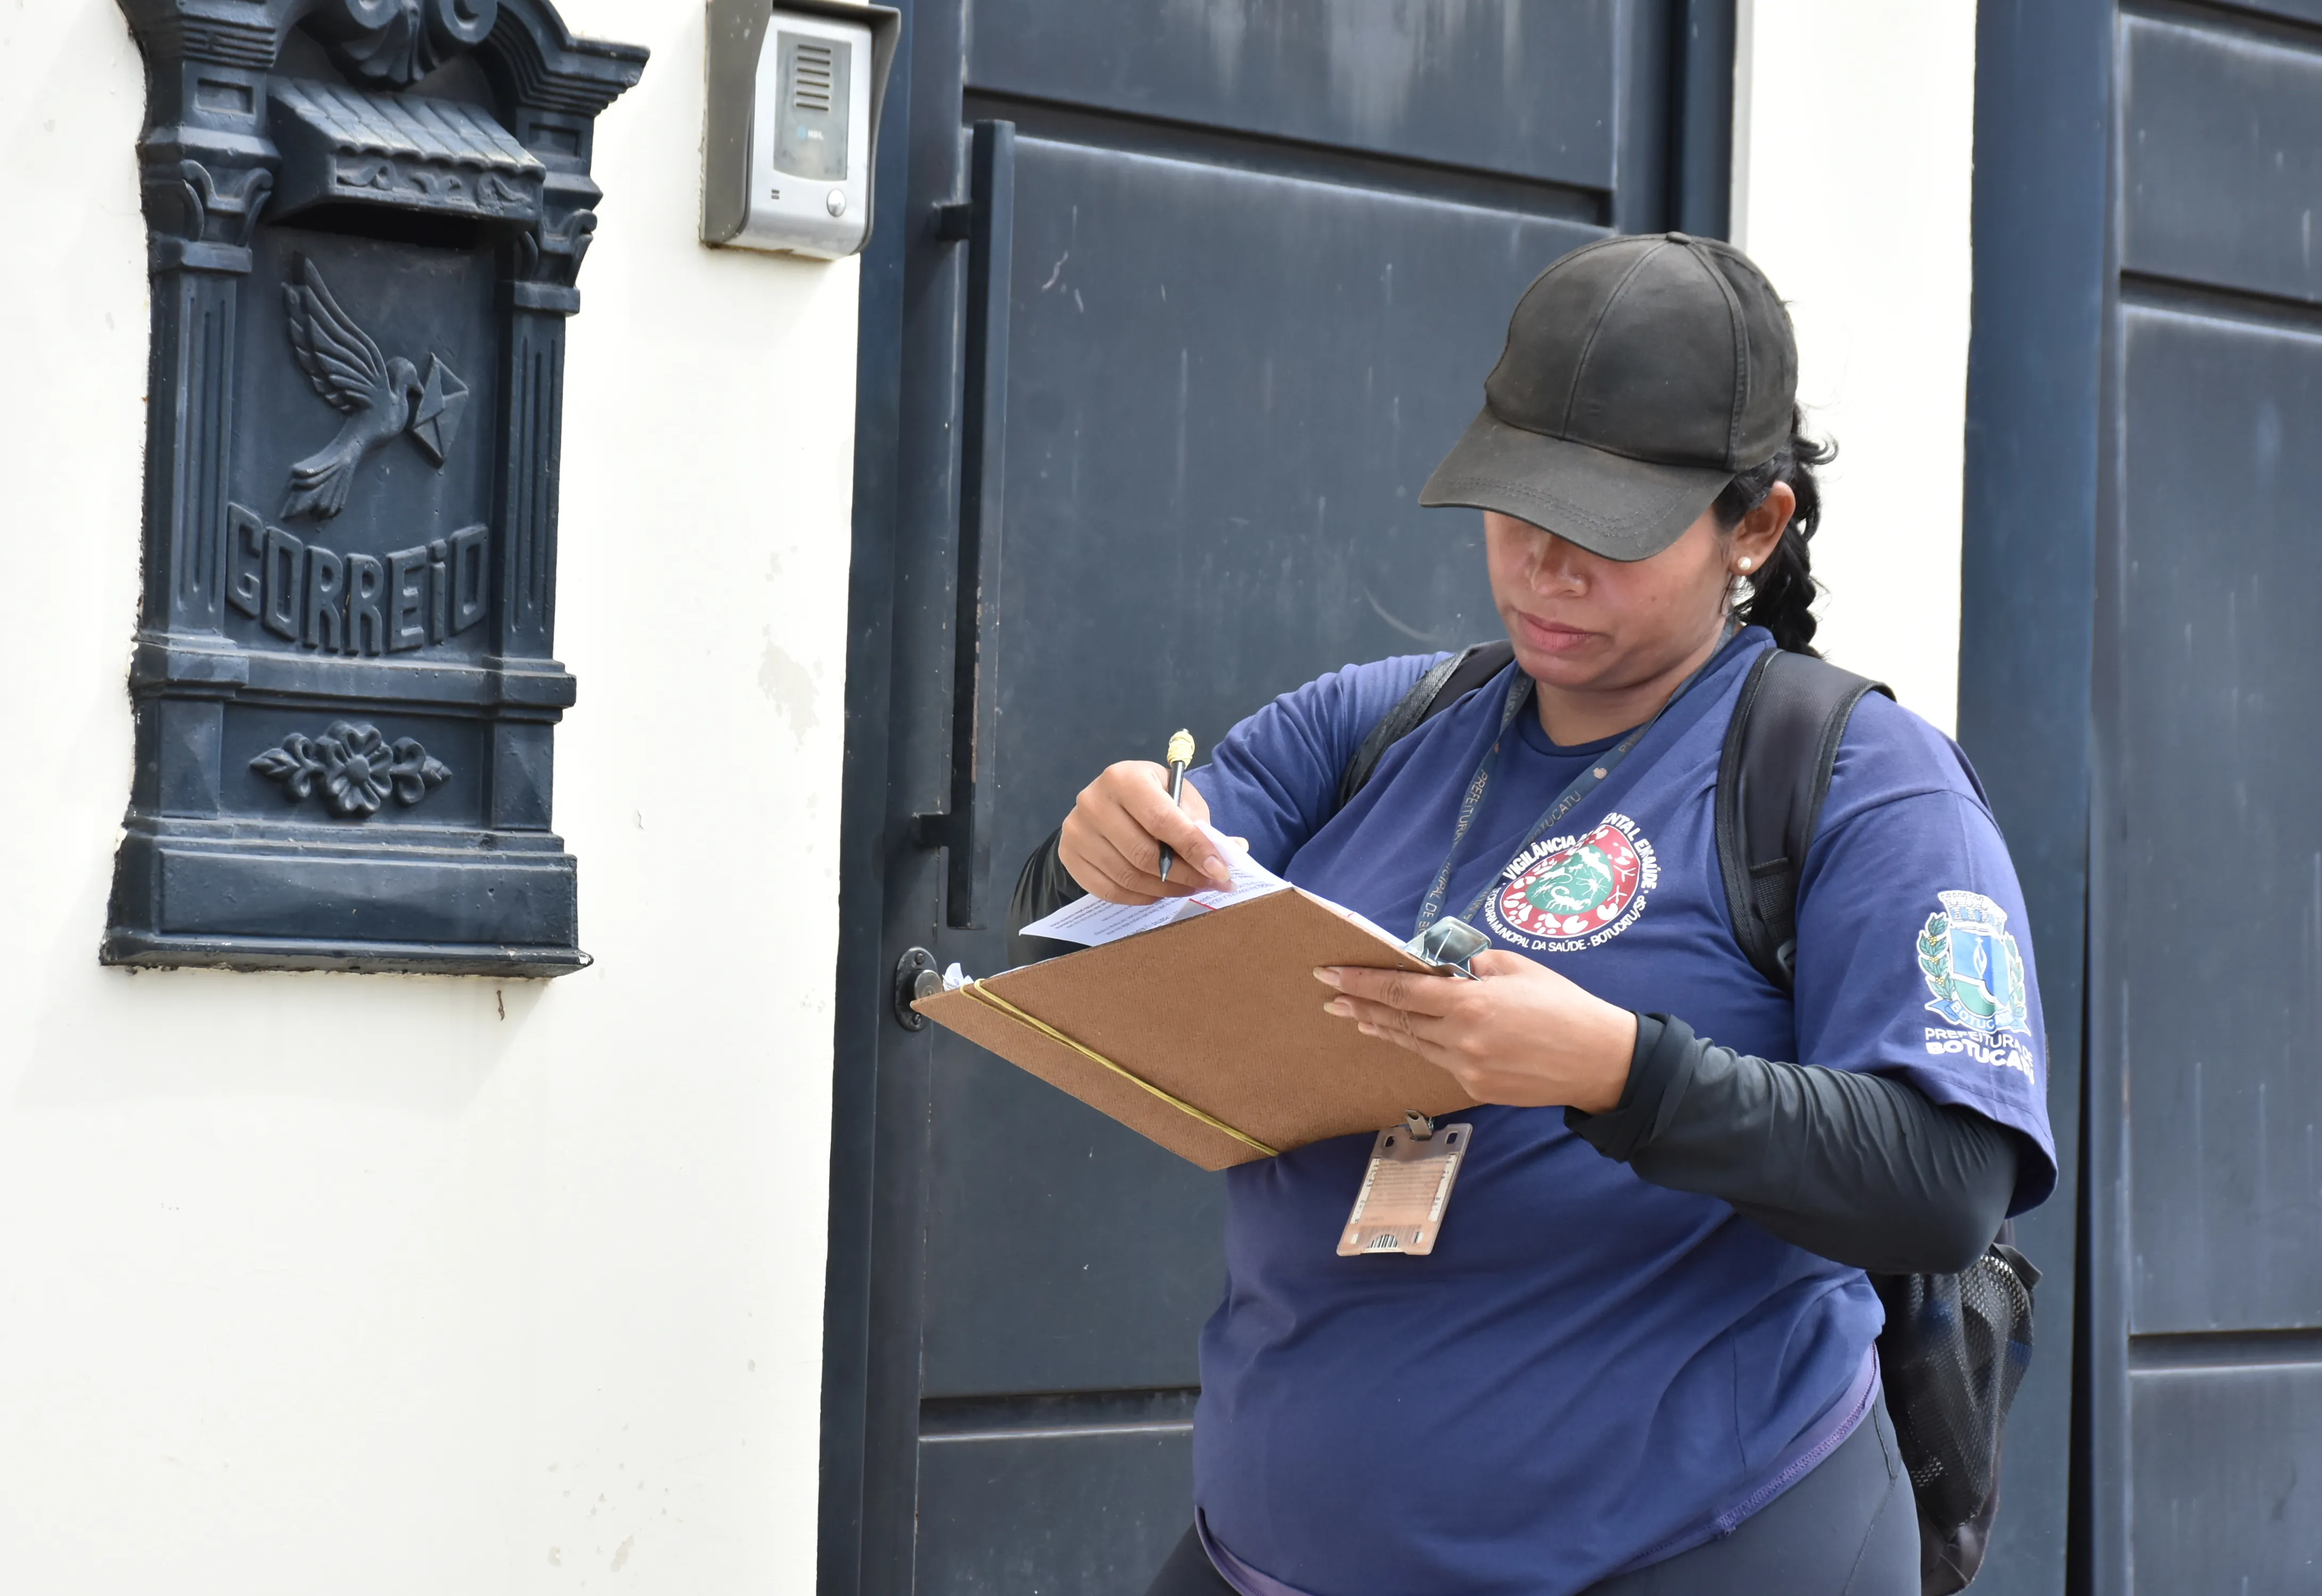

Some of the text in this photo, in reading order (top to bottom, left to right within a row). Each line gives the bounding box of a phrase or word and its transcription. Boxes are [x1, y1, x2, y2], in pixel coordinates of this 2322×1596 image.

[1503, 835, 1577, 880] VIGILÂNCIA
[1423, 902, 1437, 918] DE
[1490, 920, 1530, 948] MUNICIPAL
[1531, 940, 1546, 950] DA
[1548, 940, 1587, 952] SAÚDE
[1925, 1027, 2021, 1052] PREFEITURA
